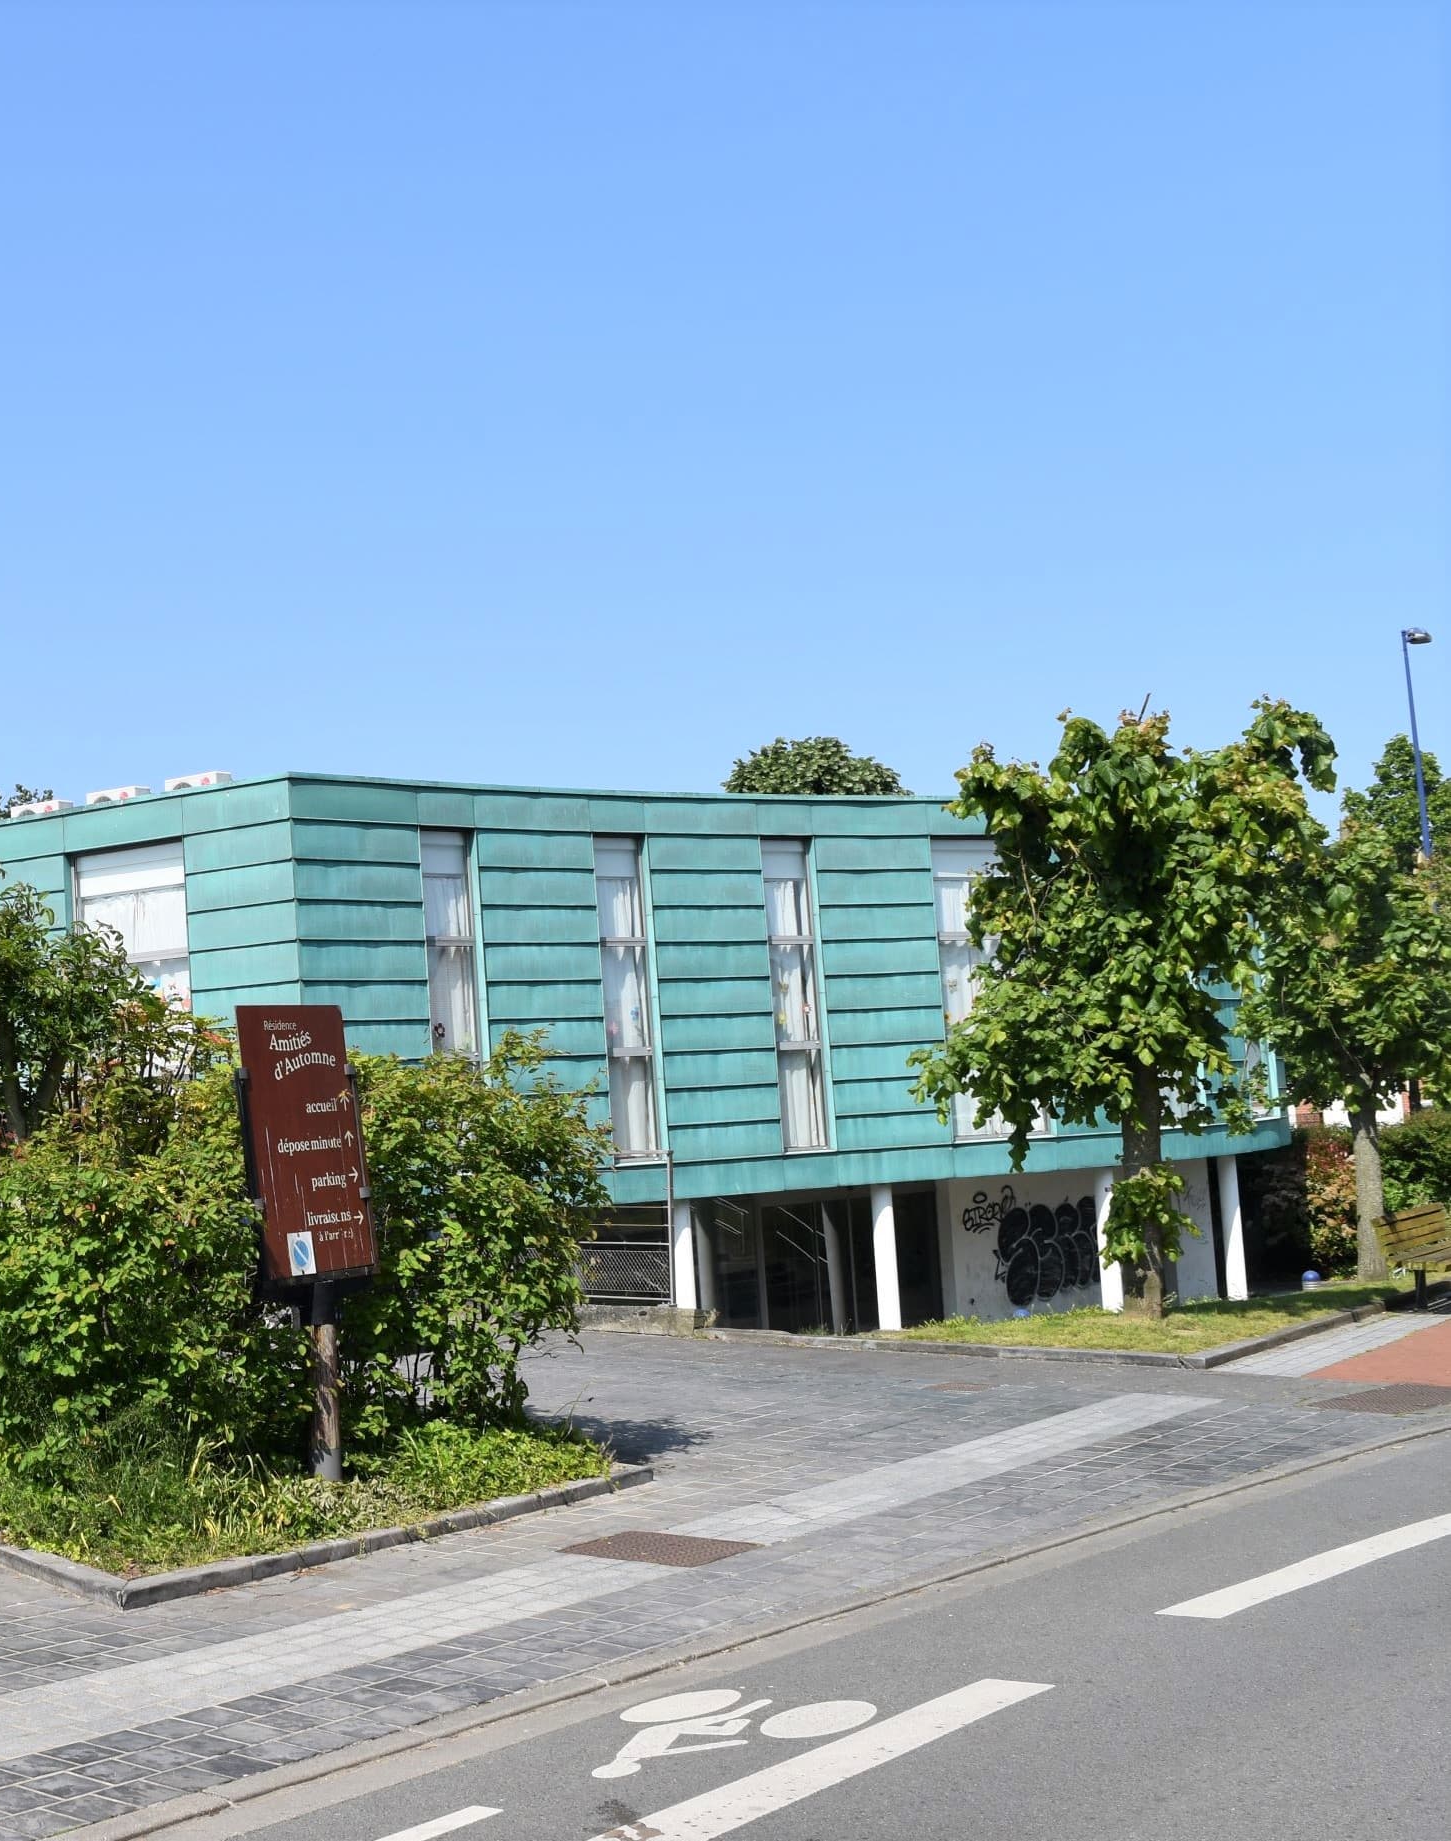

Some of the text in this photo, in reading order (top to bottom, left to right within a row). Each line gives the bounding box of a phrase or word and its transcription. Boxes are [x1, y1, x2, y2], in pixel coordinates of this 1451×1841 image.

[263, 1020, 297, 1031] Résidence
[269, 1030, 312, 1051] Amitiés
[274, 1051, 336, 1081] d'Automne
[306, 1098, 338, 1113] accueil
[277, 1136, 342, 1157] dépose minute
[311, 1172, 347, 1192] parking
